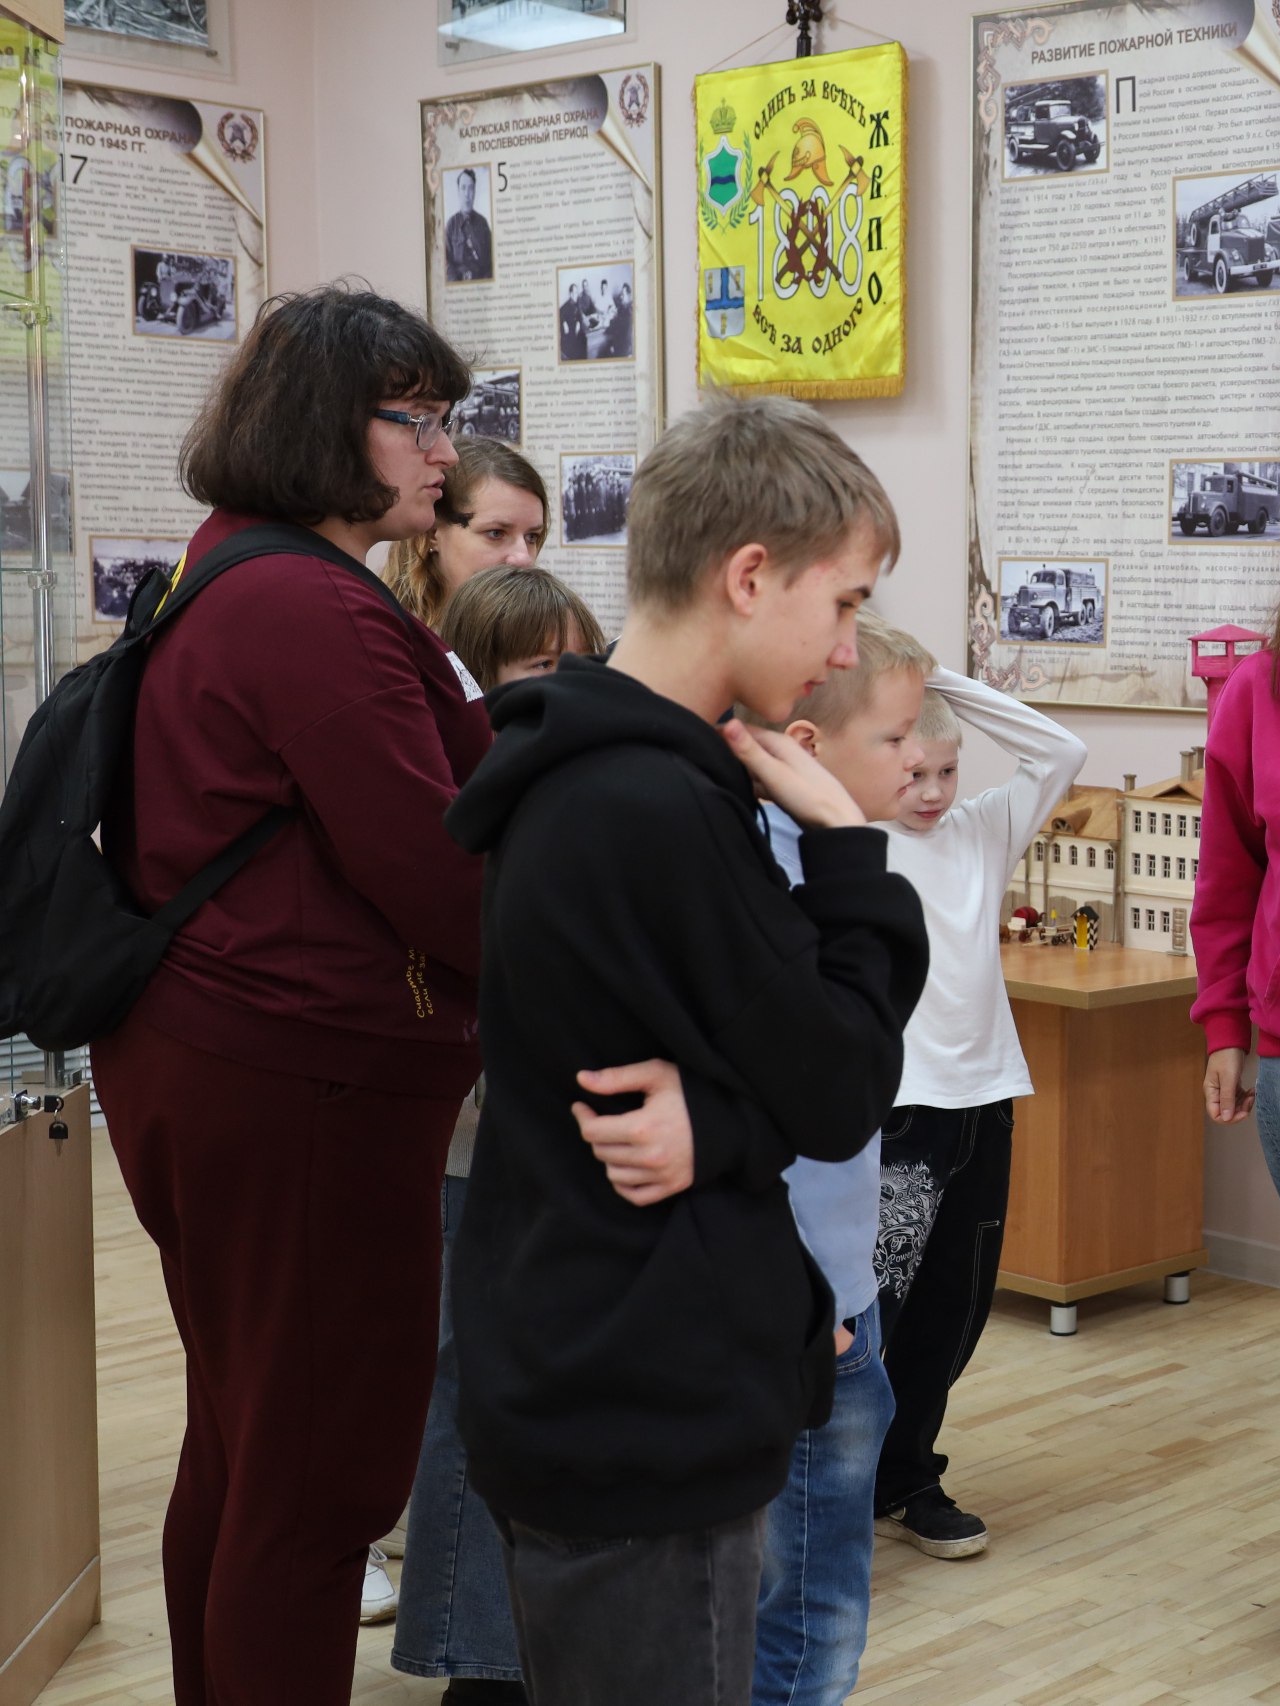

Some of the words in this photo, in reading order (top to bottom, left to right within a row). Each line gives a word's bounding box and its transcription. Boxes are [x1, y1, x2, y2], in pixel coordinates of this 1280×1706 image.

[1031, 42, 1095, 64] РАЗВИТИЕ
[1099, 29, 1172, 55] ПОЖАРНОЙ
[1178, 22, 1237, 44] ТЕХНИКИ
[754, 86, 796, 140] ОДИНЪ
[802, 79, 816, 101] ЗА
[1116, 76, 1136, 113] П
[65, 116, 141, 137] ПОЖАРНАЯ
[459, 122, 510, 139] КАЛУЖСКАЯ
[512, 113, 561, 131] ПОЖАРНАЯ
[564, 108, 598, 123] ОХРАНА
[471, 143, 475, 152] В
[479, 129, 550, 151] ПОСЛЕВОЕННЫЙ
[553, 126, 588, 139] ПЕРИОД
[76, 135, 95, 146] ПО
[100, 137, 127, 150] 1945
[131, 142, 147, 153] ГГ.
[498, 162, 507, 192] 5
[749, 183, 863, 301] 1898
[781, 334, 803, 354] ЗА
[812, 297, 862, 355] ОДНОГО
